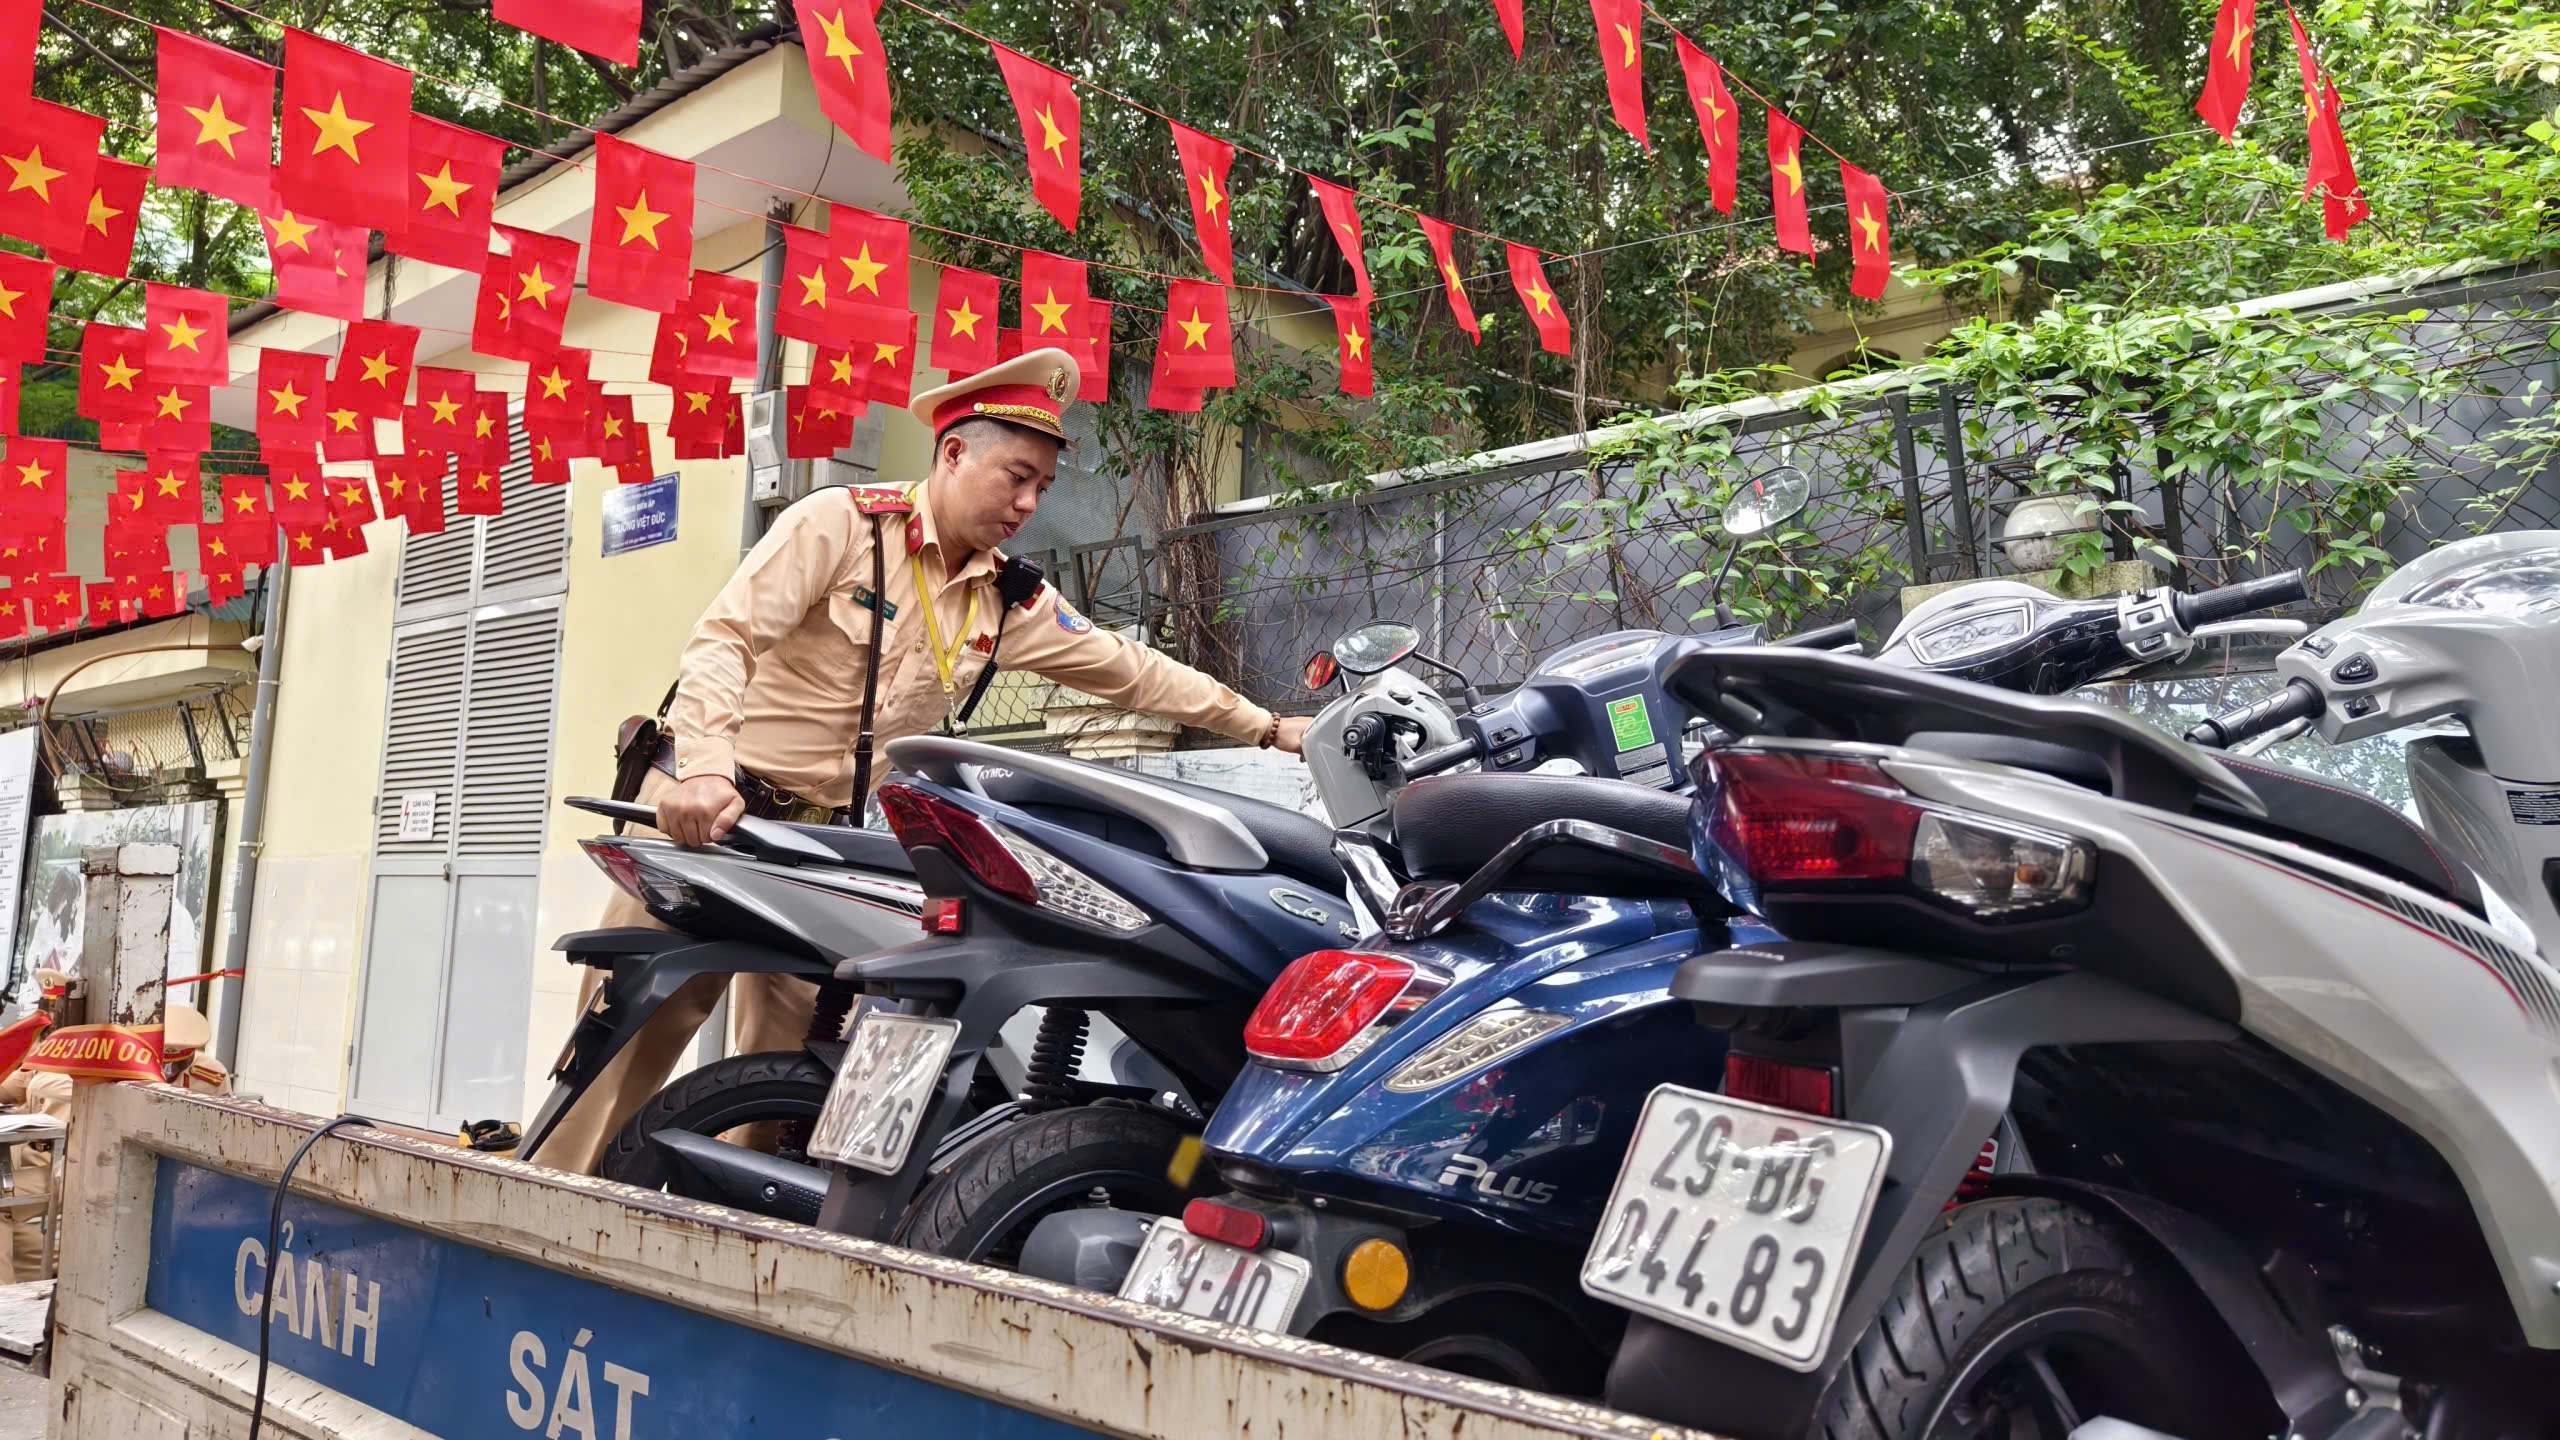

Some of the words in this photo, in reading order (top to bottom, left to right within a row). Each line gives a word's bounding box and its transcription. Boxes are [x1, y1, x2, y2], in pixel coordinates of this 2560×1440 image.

[118, 1041, 153, 1065] DO
[234, 1220, 380, 1367] CẢNH
[1604, 1197, 1826, 1341] 044.83
[506, 1327, 650, 1440] SÁT
